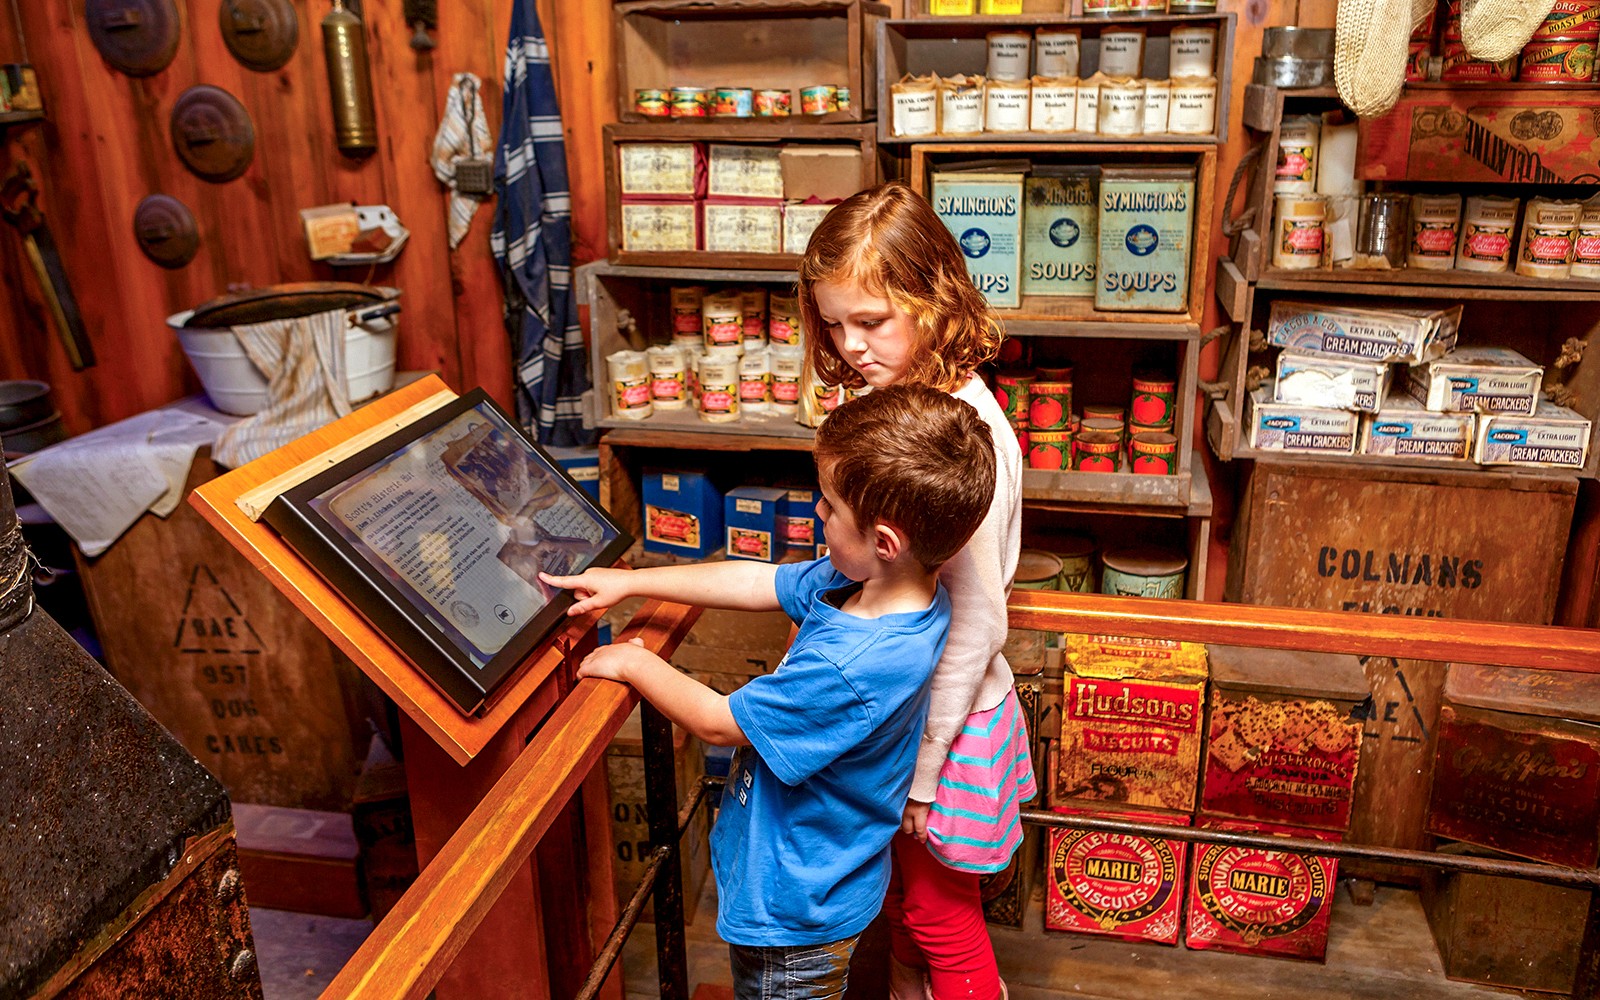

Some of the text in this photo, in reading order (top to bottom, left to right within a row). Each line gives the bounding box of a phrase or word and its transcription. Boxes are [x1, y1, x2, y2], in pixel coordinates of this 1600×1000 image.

[1548, 16, 1577, 33] ROAST
[1524, 47, 1553, 65] MUTTON
[1029, 261, 1096, 281] SOUPS
[1104, 271, 1177, 292] SOUPS
[1281, 315, 1309, 341] JACOB
[1349, 325, 1375, 336] EXTRA
[1325, 337, 1359, 354] CREAM
[1488, 380, 1528, 389] EXTRA LIGHT
[1354, 394, 1374, 407] KERS
[1463, 396, 1530, 411] CREAM CRACKERS
[1310, 418, 1349, 427] EXTRA LIGHT
[1422, 425, 1460, 434] EXTRA LIGHT
[1286, 433, 1351, 449] CREAM CRACKERS
[1397, 439, 1464, 455] CREAM CRACKERS
[1537, 432, 1577, 442] EXTRA LIGHT
[1511, 447, 1580, 464] CREAM CRACKERS
[344, 471, 414, 521] Scott's Historic Hut
[1317, 546, 1484, 589] COLMANS
[212, 698, 259, 720] DOG
[1074, 682, 1193, 722] Hudsons
[205, 734, 284, 755] CAKES
[1089, 733, 1173, 751] BISCUITS
[1091, 762, 1138, 779] FLOUR
[1452, 745, 1588, 782] Griffin's
[1464, 787, 1564, 820] BISCUITS
[1069, 833, 1159, 887] HUNTLEY & PALMERS
[1148, 837, 1175, 882] ISCUITS
[1087, 859, 1141, 883] MARIE
[1232, 871, 1289, 897] MARIE
[1076, 883, 1149, 910] BISCUITS
[1219, 894, 1295, 923] BISCUITS
